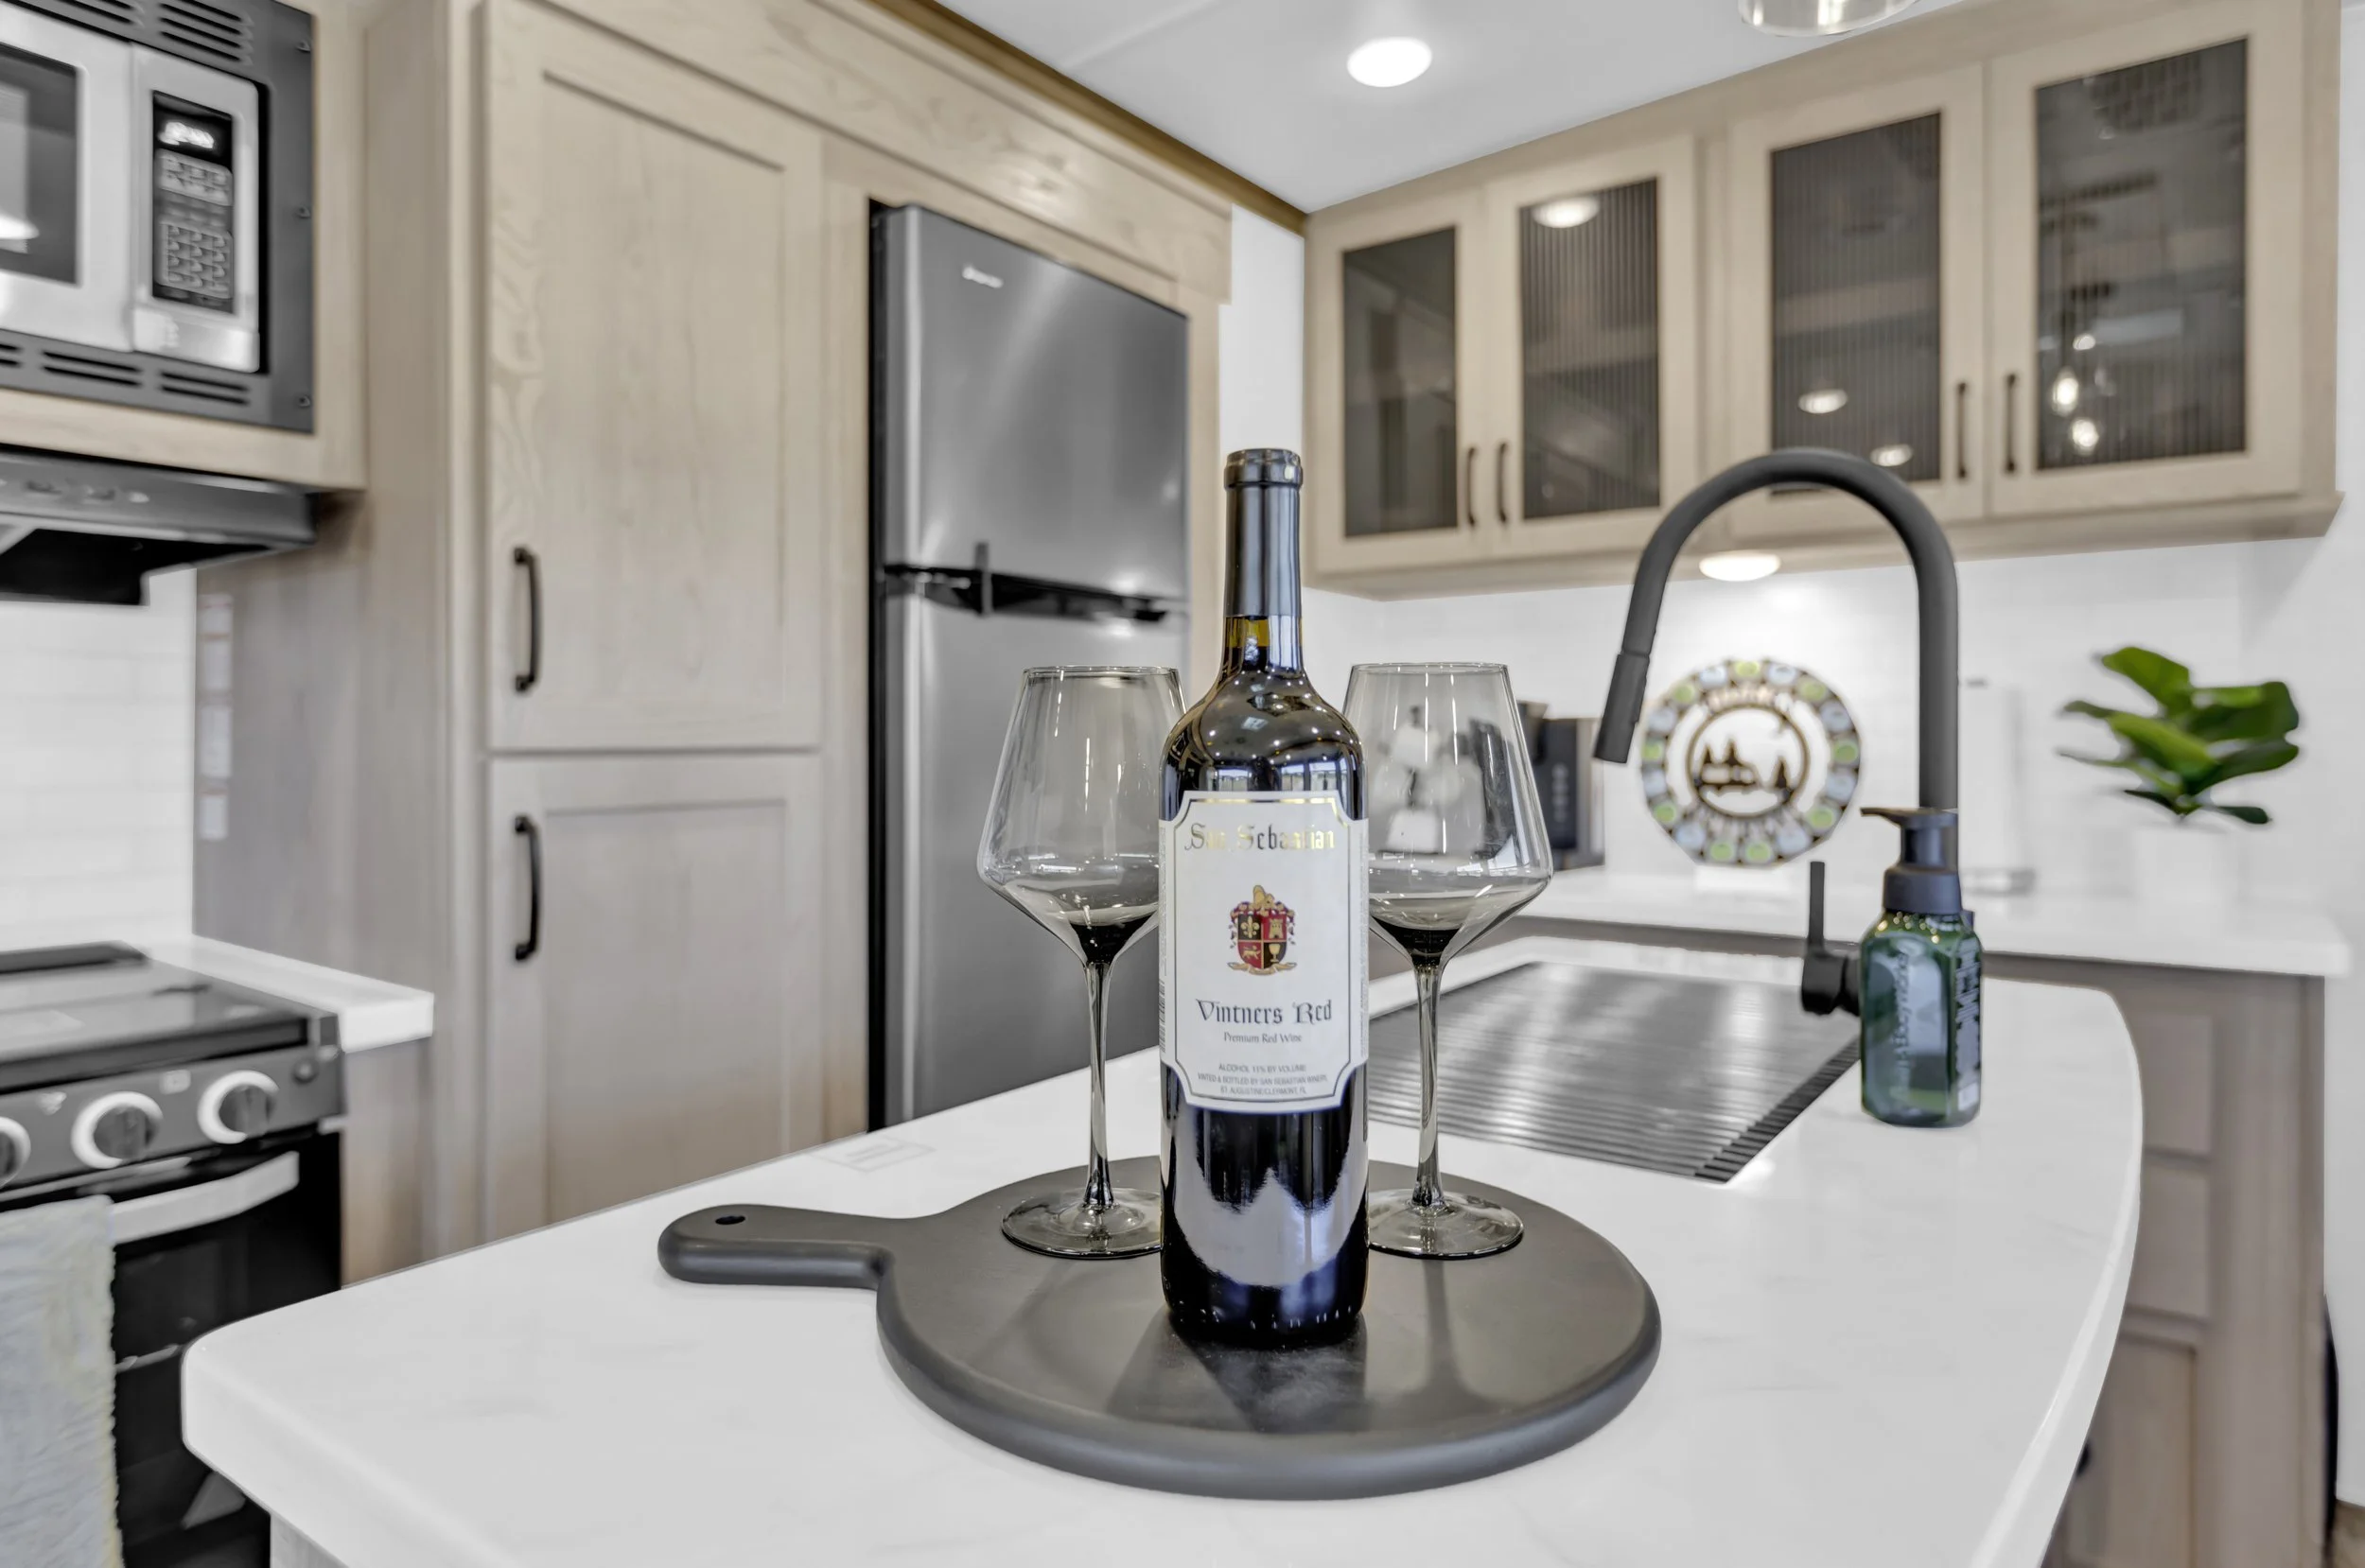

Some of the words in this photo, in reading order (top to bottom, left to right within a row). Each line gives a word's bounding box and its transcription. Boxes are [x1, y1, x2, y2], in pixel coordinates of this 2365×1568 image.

[1184, 823, 1226, 851] San
[1196, 999, 1284, 1025] Vintners
[1292, 999, 1333, 1025] Red
[1223, 1031, 1260, 1044] Premium
[1262, 1033, 1278, 1044] Red
[1279, 1033, 1303, 1043] Wine
[1218, 1062, 1251, 1072] ALCOHOL
